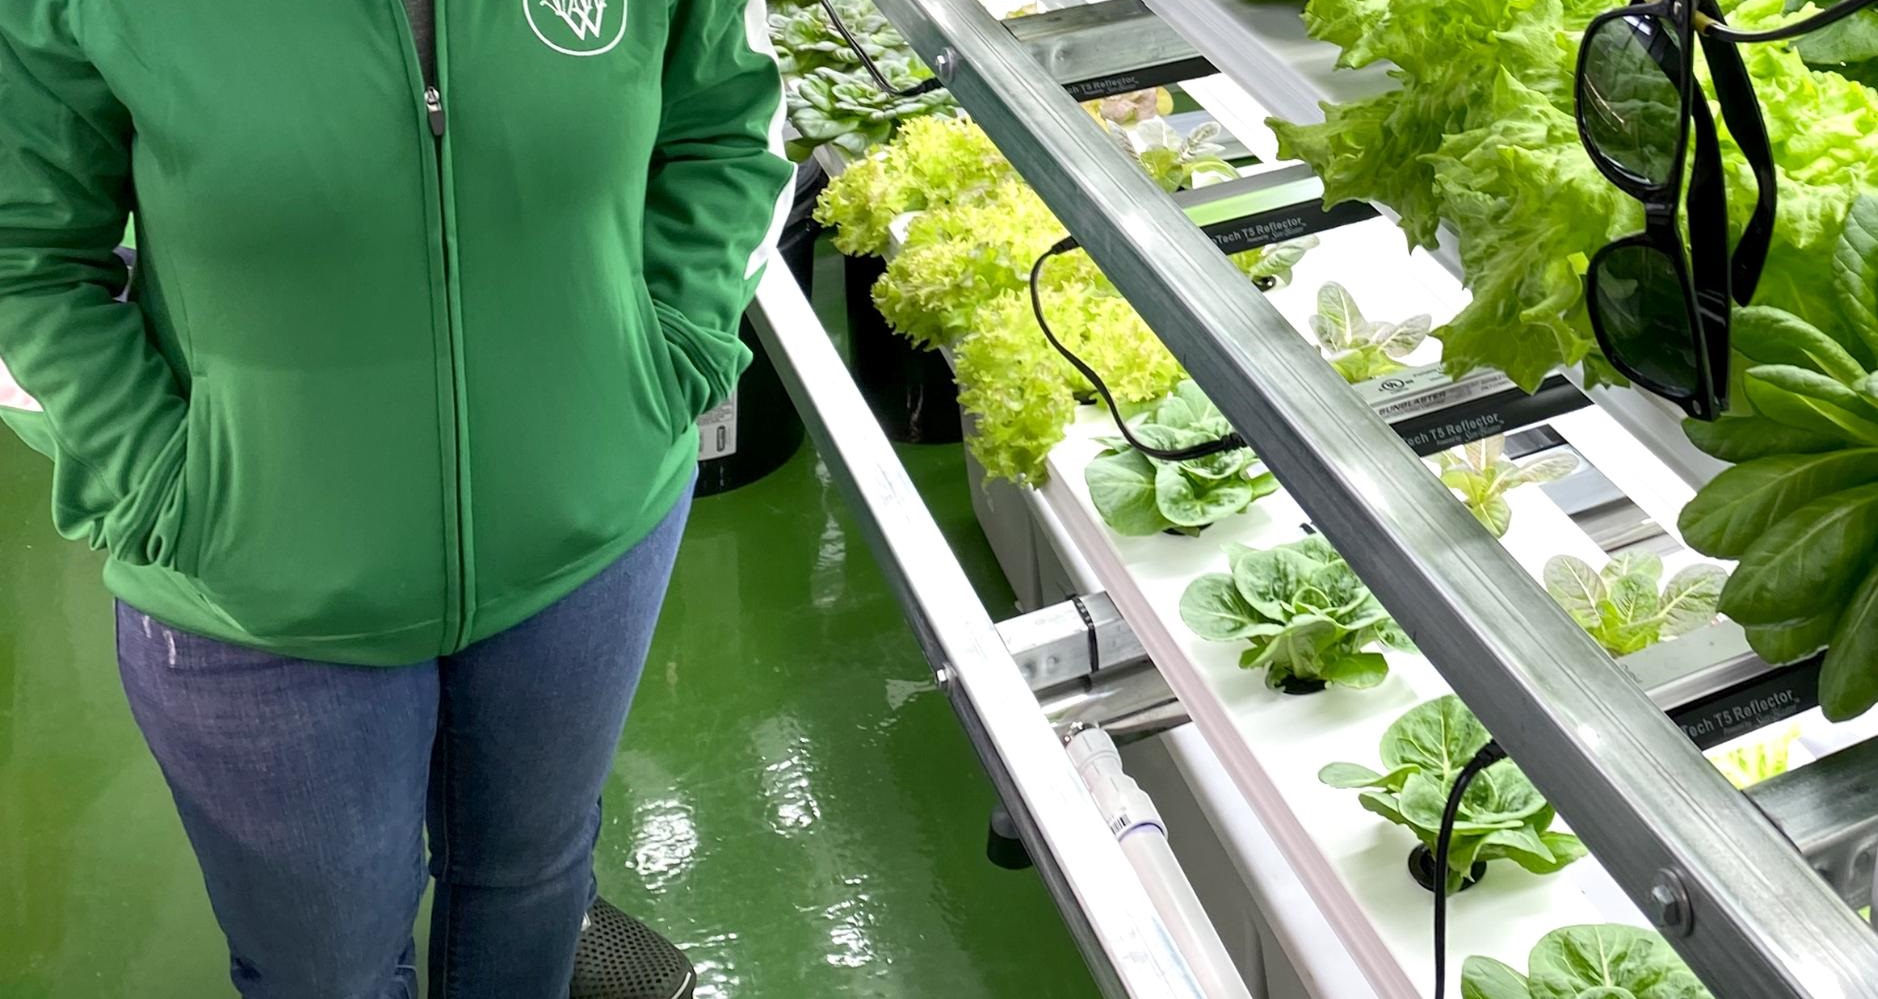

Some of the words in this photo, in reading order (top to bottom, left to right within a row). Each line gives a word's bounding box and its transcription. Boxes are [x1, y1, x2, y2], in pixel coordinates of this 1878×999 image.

[1092, 76, 1135, 90] Reflector
[1255, 217, 1302, 235] Reflector
[1429, 427, 1446, 439] T5
[1446, 413, 1499, 436] Reflector
[1713, 711, 1733, 728] T5
[1734, 689, 1793, 721] Reflector
